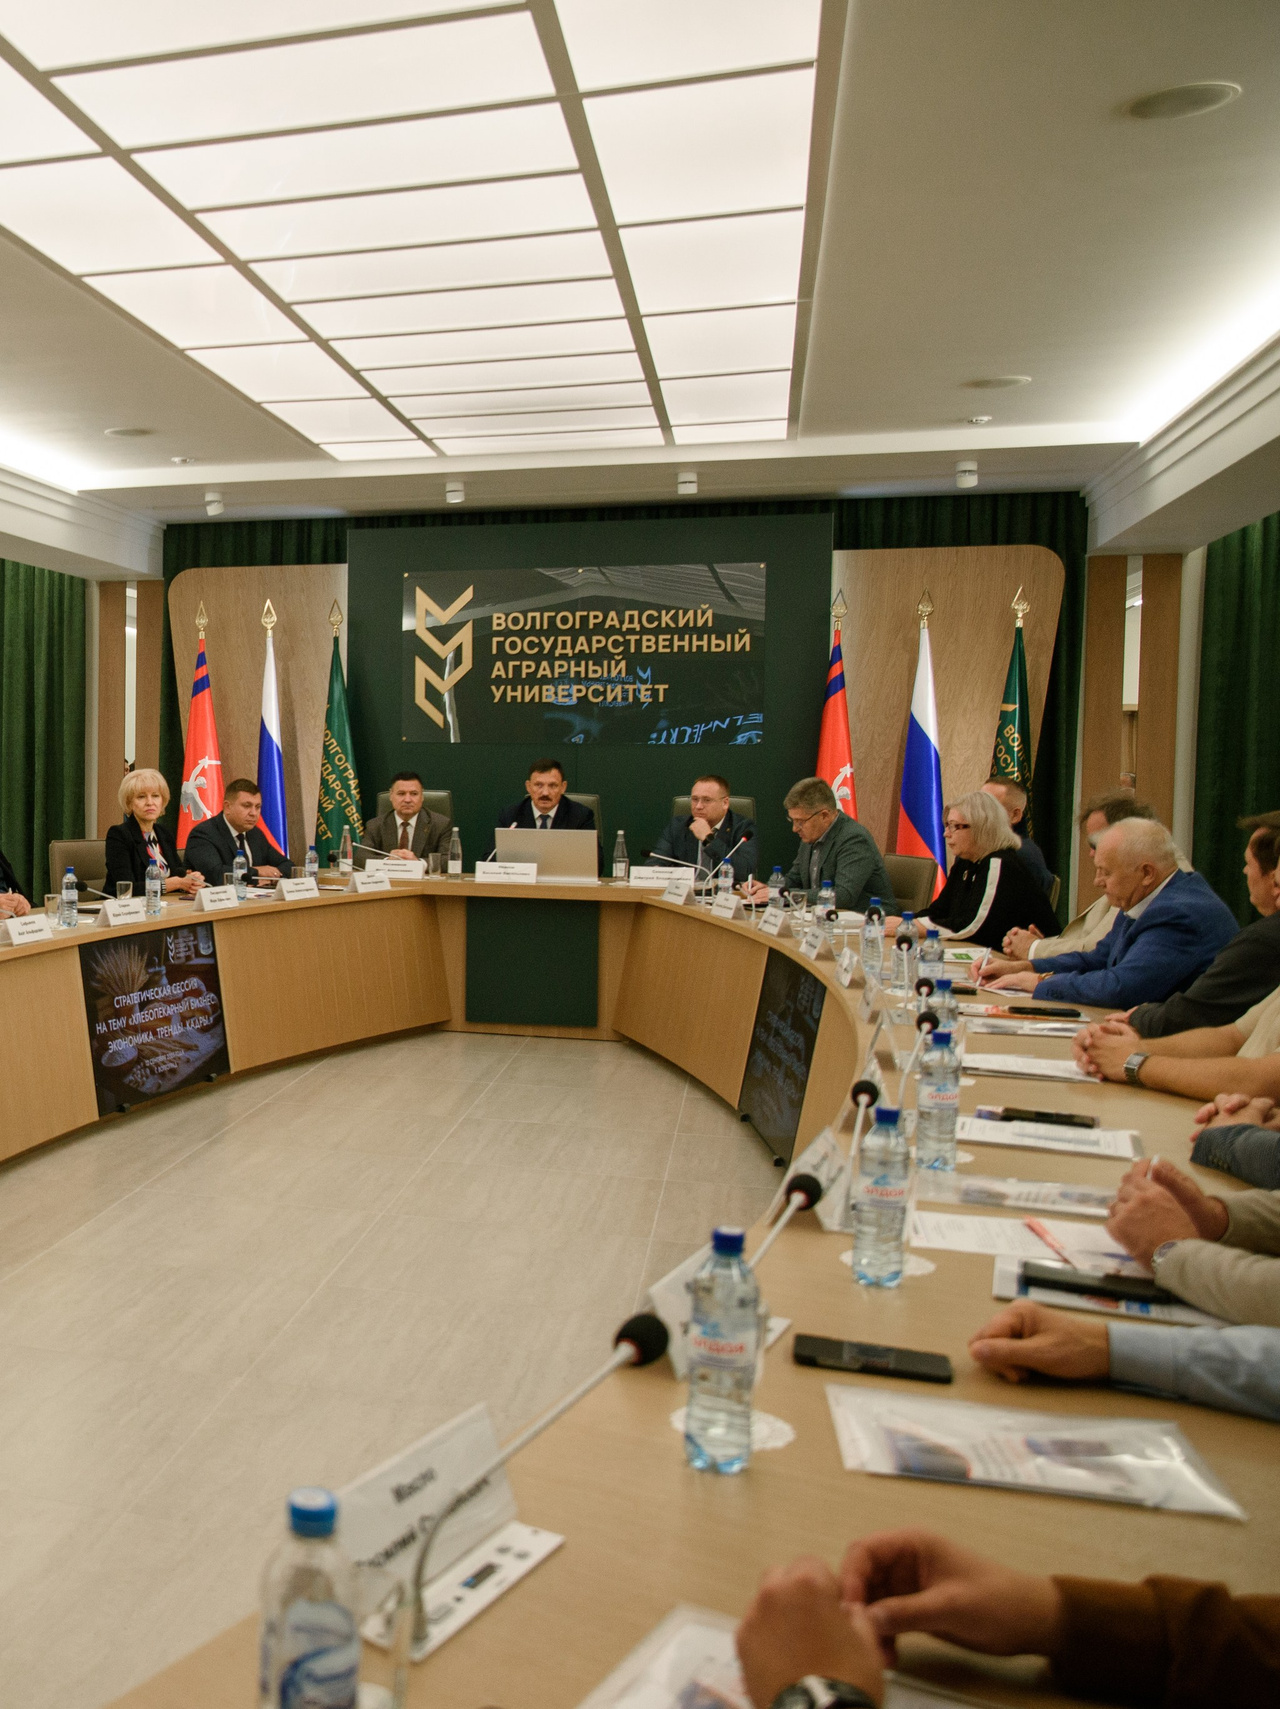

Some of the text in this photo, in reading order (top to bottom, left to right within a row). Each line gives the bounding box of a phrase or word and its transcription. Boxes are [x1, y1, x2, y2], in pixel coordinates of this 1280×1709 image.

[491, 603, 713, 631] ВОЛГОГРАДСКИЙ
[491, 628, 751, 657] ГОСУДАРСТВЕННЫЙ
[491, 655, 627, 679] АГРАРНЫЙ
[490, 684, 669, 703] УНИВЕРСИТЕТ
[114, 978, 197, 1008] СТРАТЕГИЧЕСКАЯ СЕССИЯ
[96, 1023, 107, 1034] НА
[108, 1017, 126, 1031] ТЕМУ
